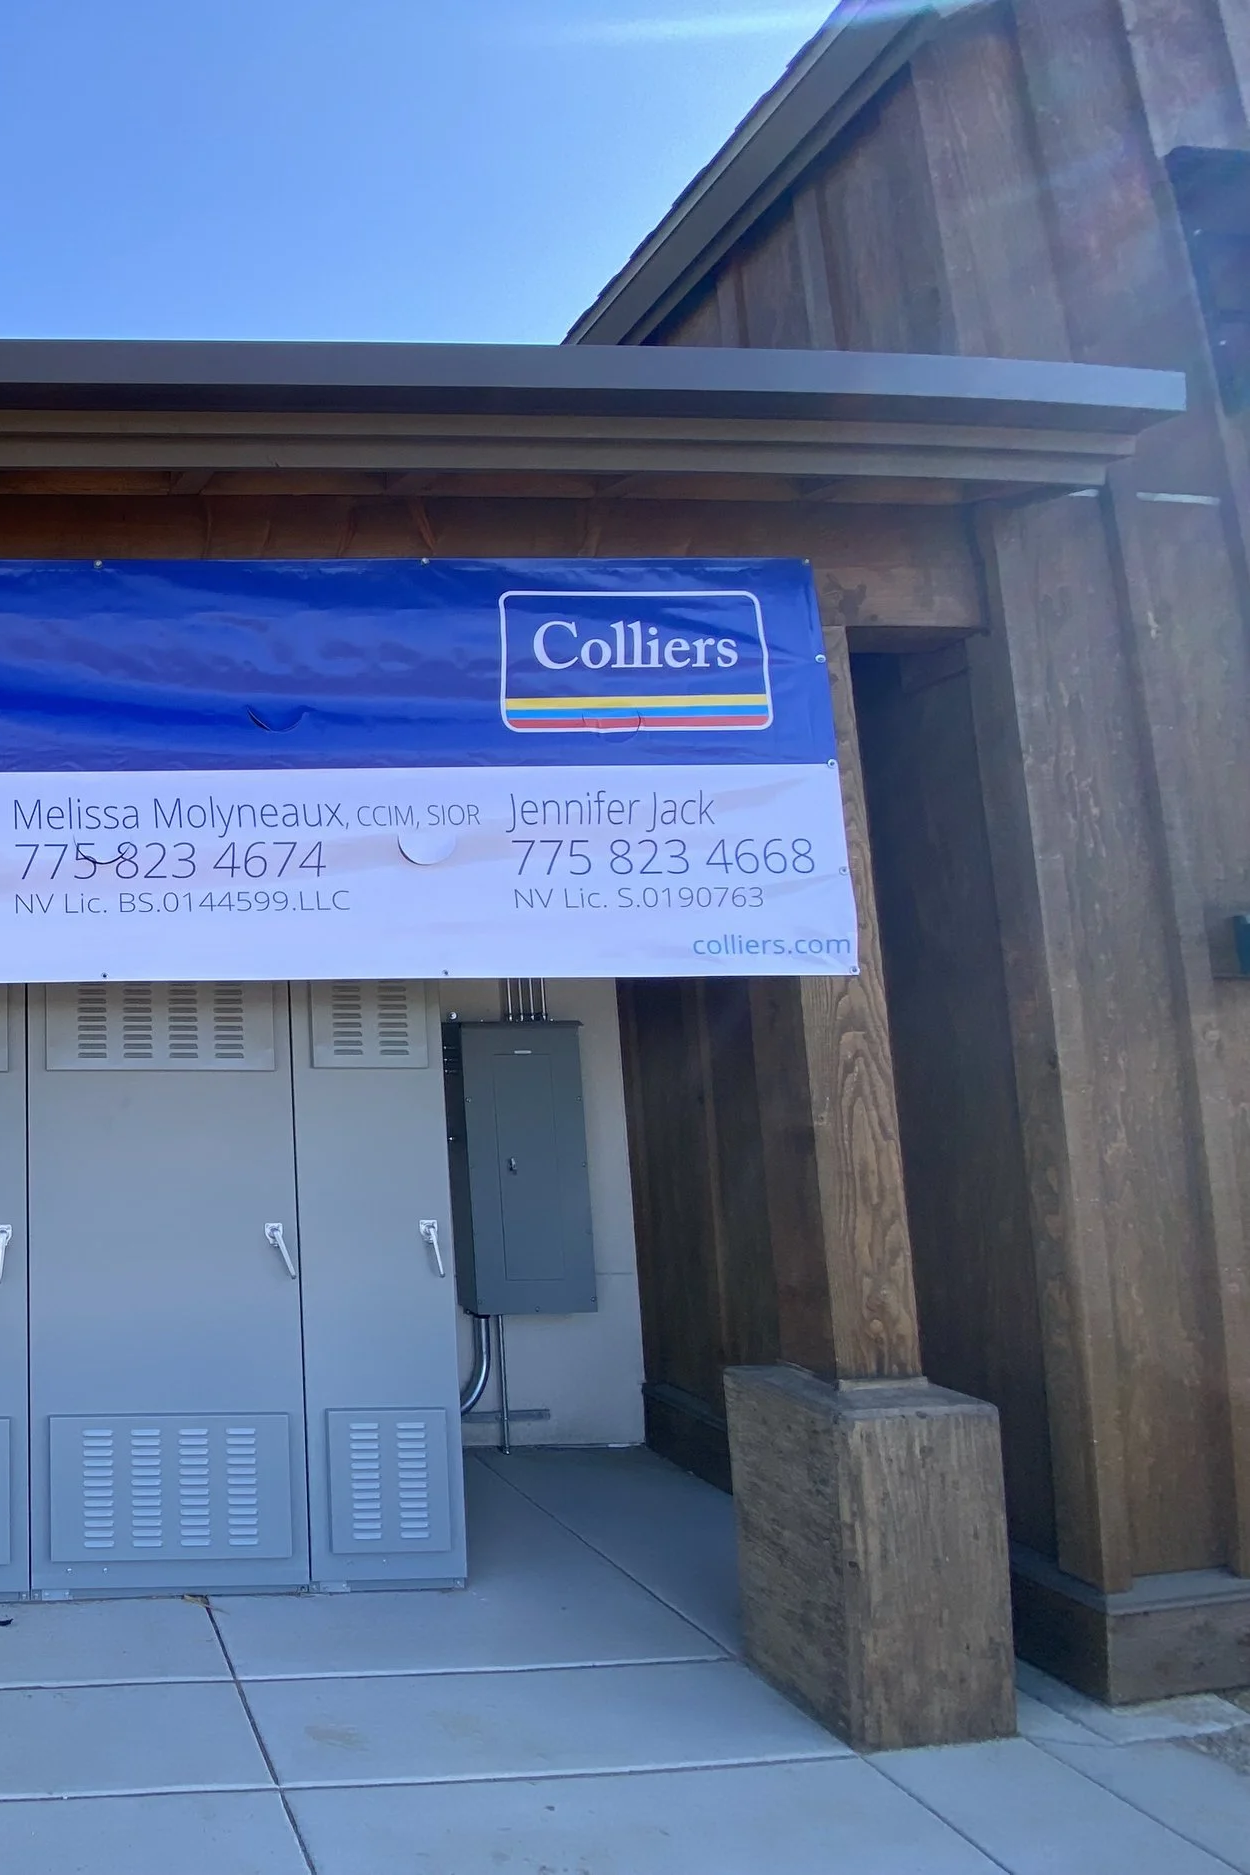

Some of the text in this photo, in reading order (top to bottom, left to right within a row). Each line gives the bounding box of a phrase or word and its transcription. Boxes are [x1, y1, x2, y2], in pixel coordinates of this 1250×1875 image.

[533, 620, 739, 670] Colliers
[13, 796, 481, 838] Melissa Molyneaux, CCIM, SIOR
[506, 790, 716, 833] Jennifer Jack
[14, 840, 327, 880] 775 823 4674
[511, 838, 815, 876] 775 823 4668
[14, 889, 350, 914] NV Lic. BS.0144599.LLC
[514, 886, 764, 909] NV Lic. S.0190763
[693, 934, 851, 955] colliers.com
